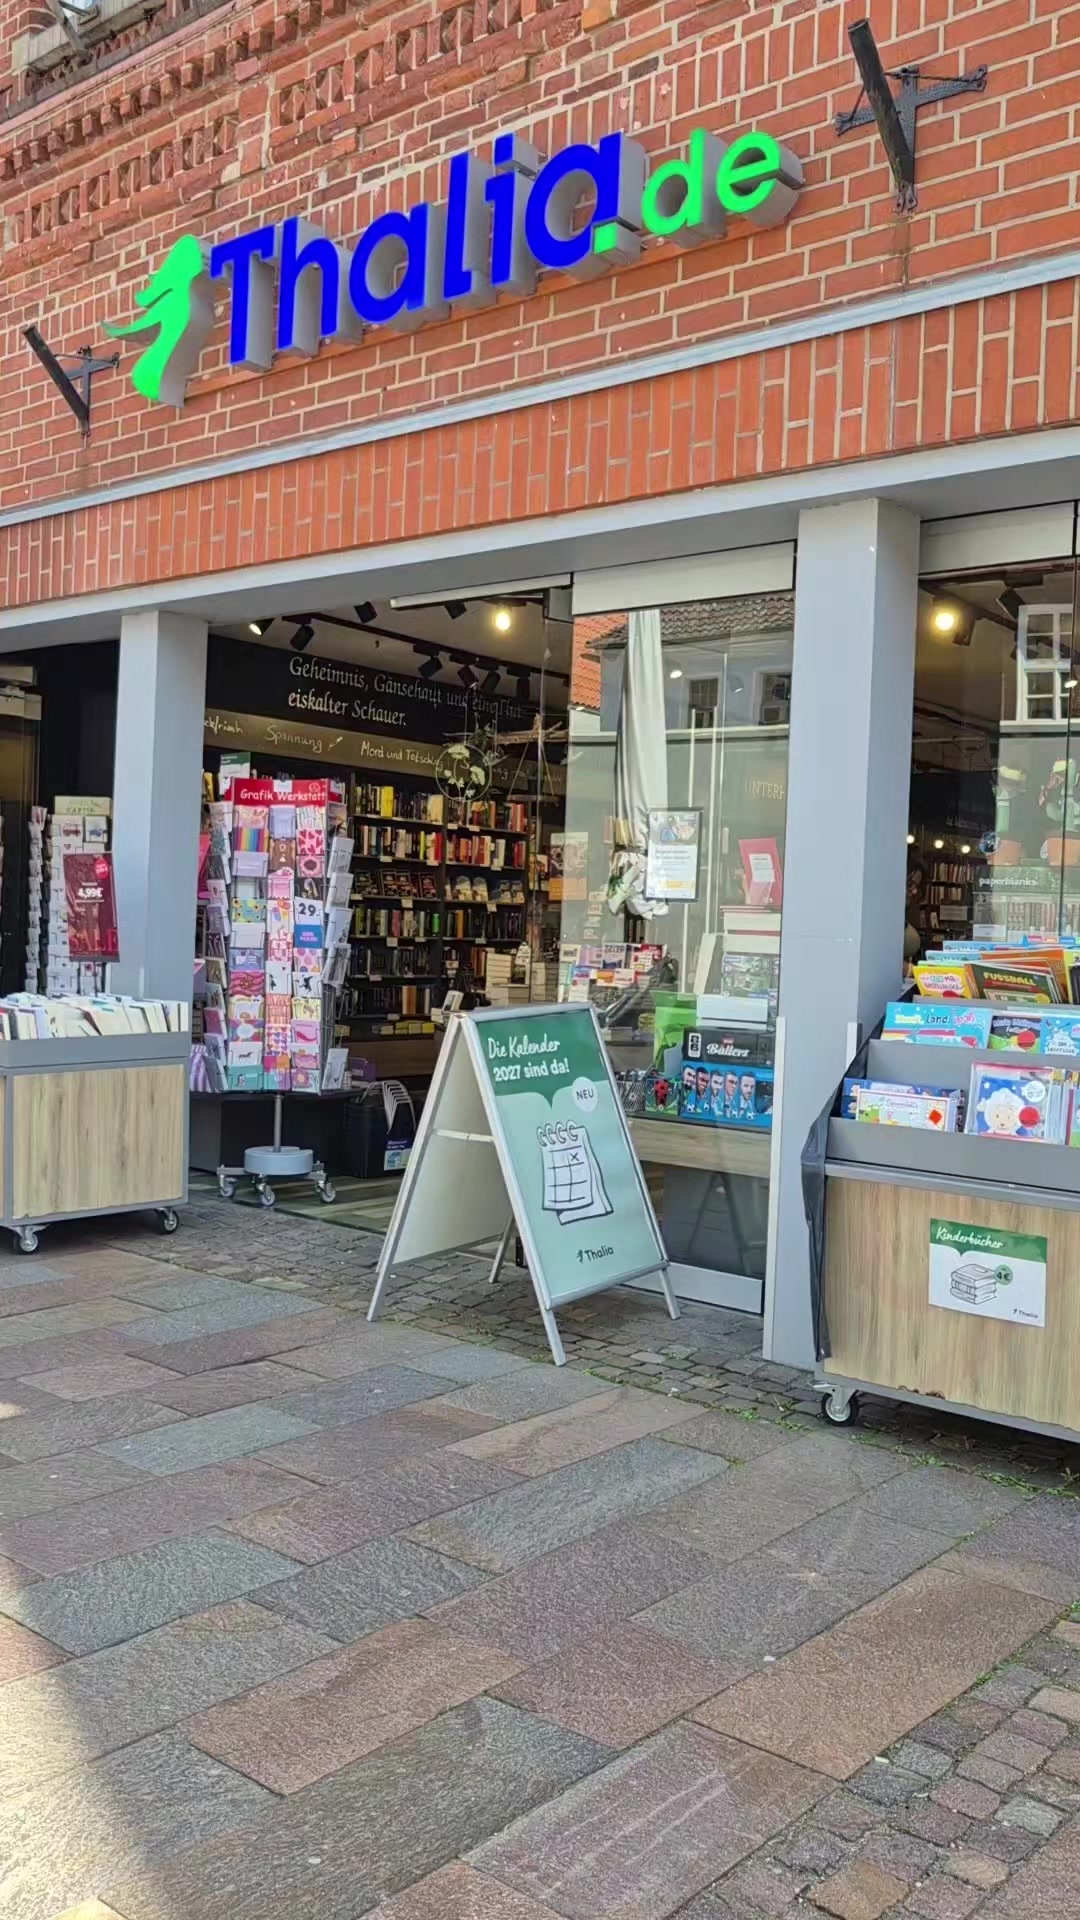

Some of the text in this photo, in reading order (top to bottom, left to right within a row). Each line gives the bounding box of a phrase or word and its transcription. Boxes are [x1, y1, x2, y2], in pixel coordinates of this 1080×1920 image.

[210, 127, 783, 367] Thalia.de
[289, 656, 369, 692] Geheimnis,
[374, 674, 442, 703] Gänsehaut
[288, 688, 407, 726] eiskalter Schauer.
[264, 725, 323, 754] Spannung
[360, 741, 385, 759] Mord
[386, 748, 403, 762] und
[240, 788, 326, 801] Grafik Werkstatt
[77, 886, 104, 900] 4,99€
[979, 876, 1037, 888] paperblanks
[69, 927, 118, 952] SALE
[983, 971, 1037, 986] FUSSBALL
[487, 1035, 561, 1059] Die Kalender
[706, 1043, 751, 1057] Ballers
[493, 1057, 571, 1082] 2027 sind da!
[575, 1089, 595, 1101] NEU
[935, 1226, 1004, 1249] Kinderbücher
[585, 1245, 614, 1261] Thalia
